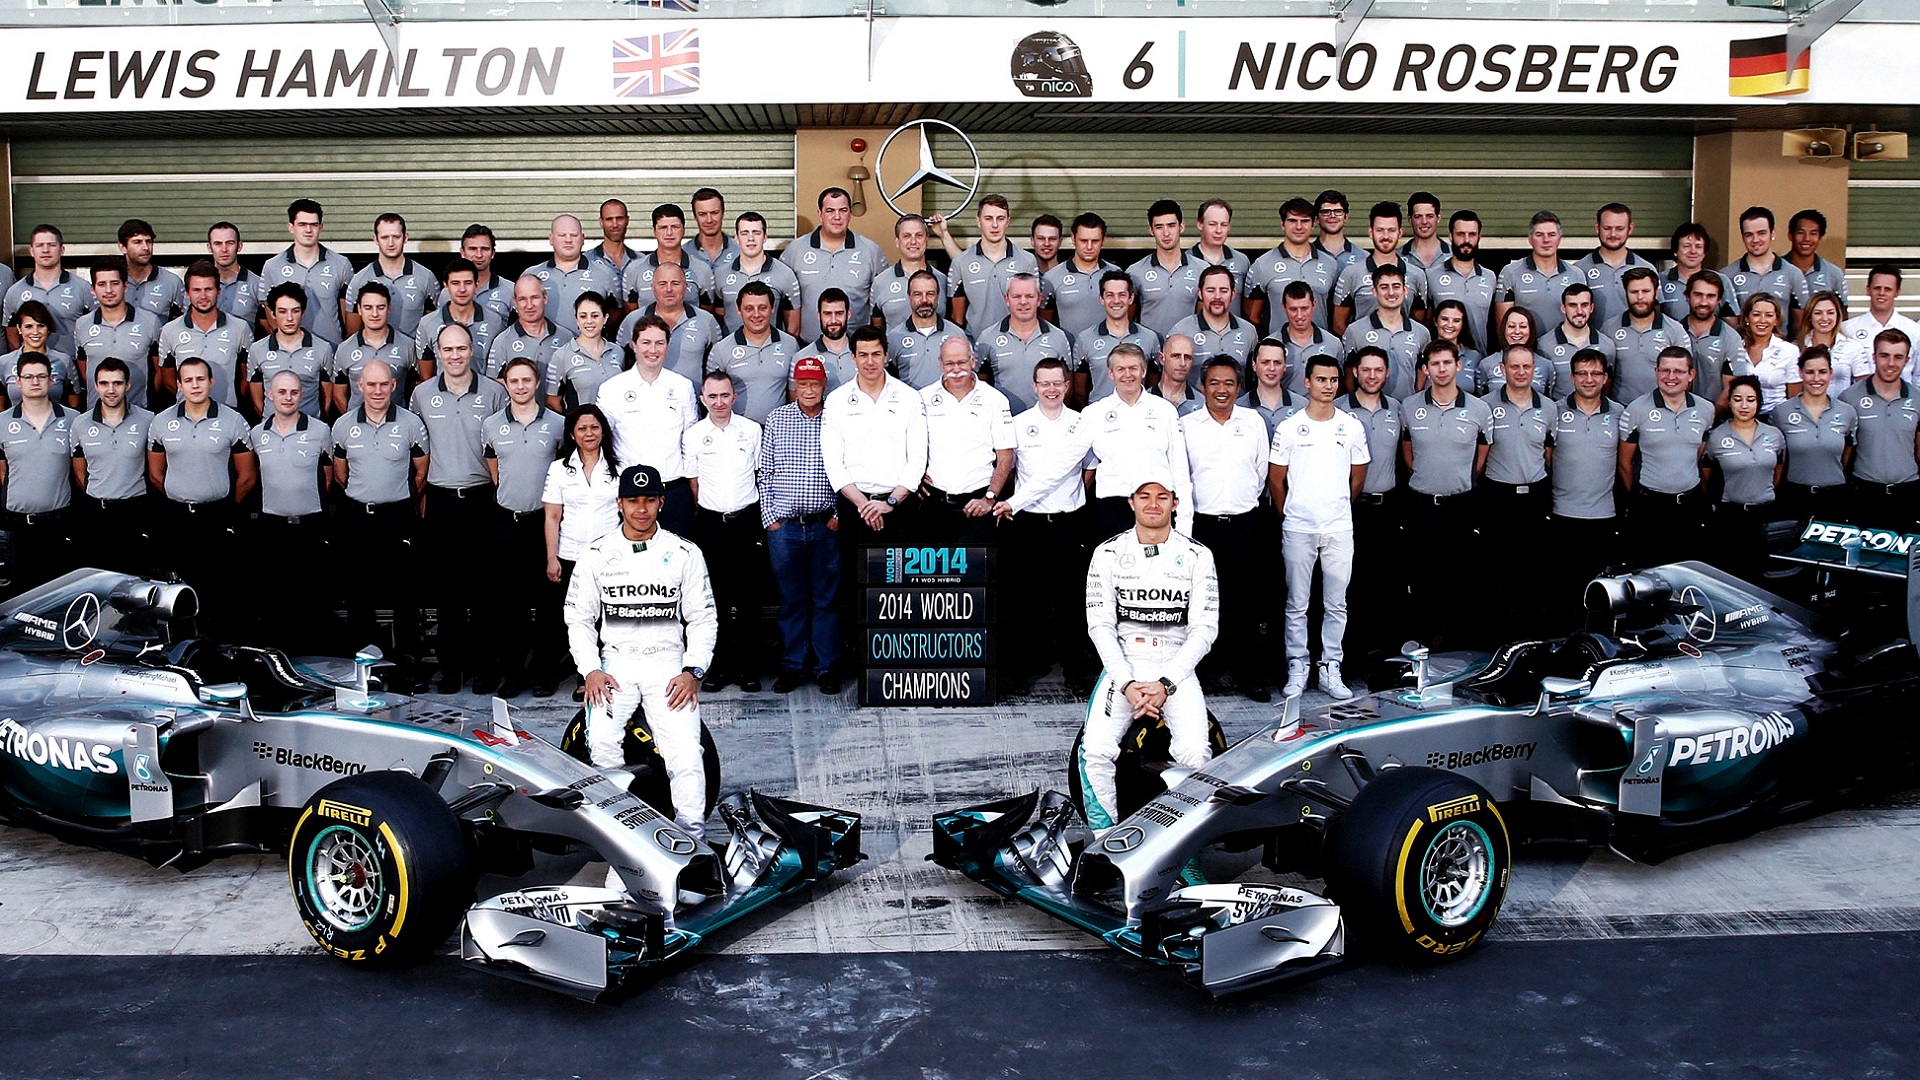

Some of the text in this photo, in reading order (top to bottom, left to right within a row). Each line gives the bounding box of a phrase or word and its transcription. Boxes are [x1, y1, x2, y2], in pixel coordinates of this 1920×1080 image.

[26, 47, 565, 100] LEWIS HAMILTON
[1123, 41, 1155, 90] 6
[1228, 41, 1679, 93] NICO ROSBERG
[886, 548, 895, 583] WORLD
[904, 547, 968, 574] 2014
[618, 606, 676, 619] BlackBerry
[878, 592, 974, 620] 2014 WORLD
[1129, 610, 1183, 623] BlackBerry
[24, 626, 55, 641] HYBRID
[872, 632, 982, 659] CONSTRUCTORS
[882, 672, 970, 699] CHAMPIONS
[1667, 710, 1796, 768] PETRONAS
[275, 747, 367, 776] BlackBerry
[1447, 740, 1538, 770] BlackBerry
[131, 783, 169, 793] PETRONAS
[1623, 776, 1660, 785] PETRONAS
[317, 799, 373, 827] PIRELLI
[1427, 794, 1481, 823] PIRELLI
